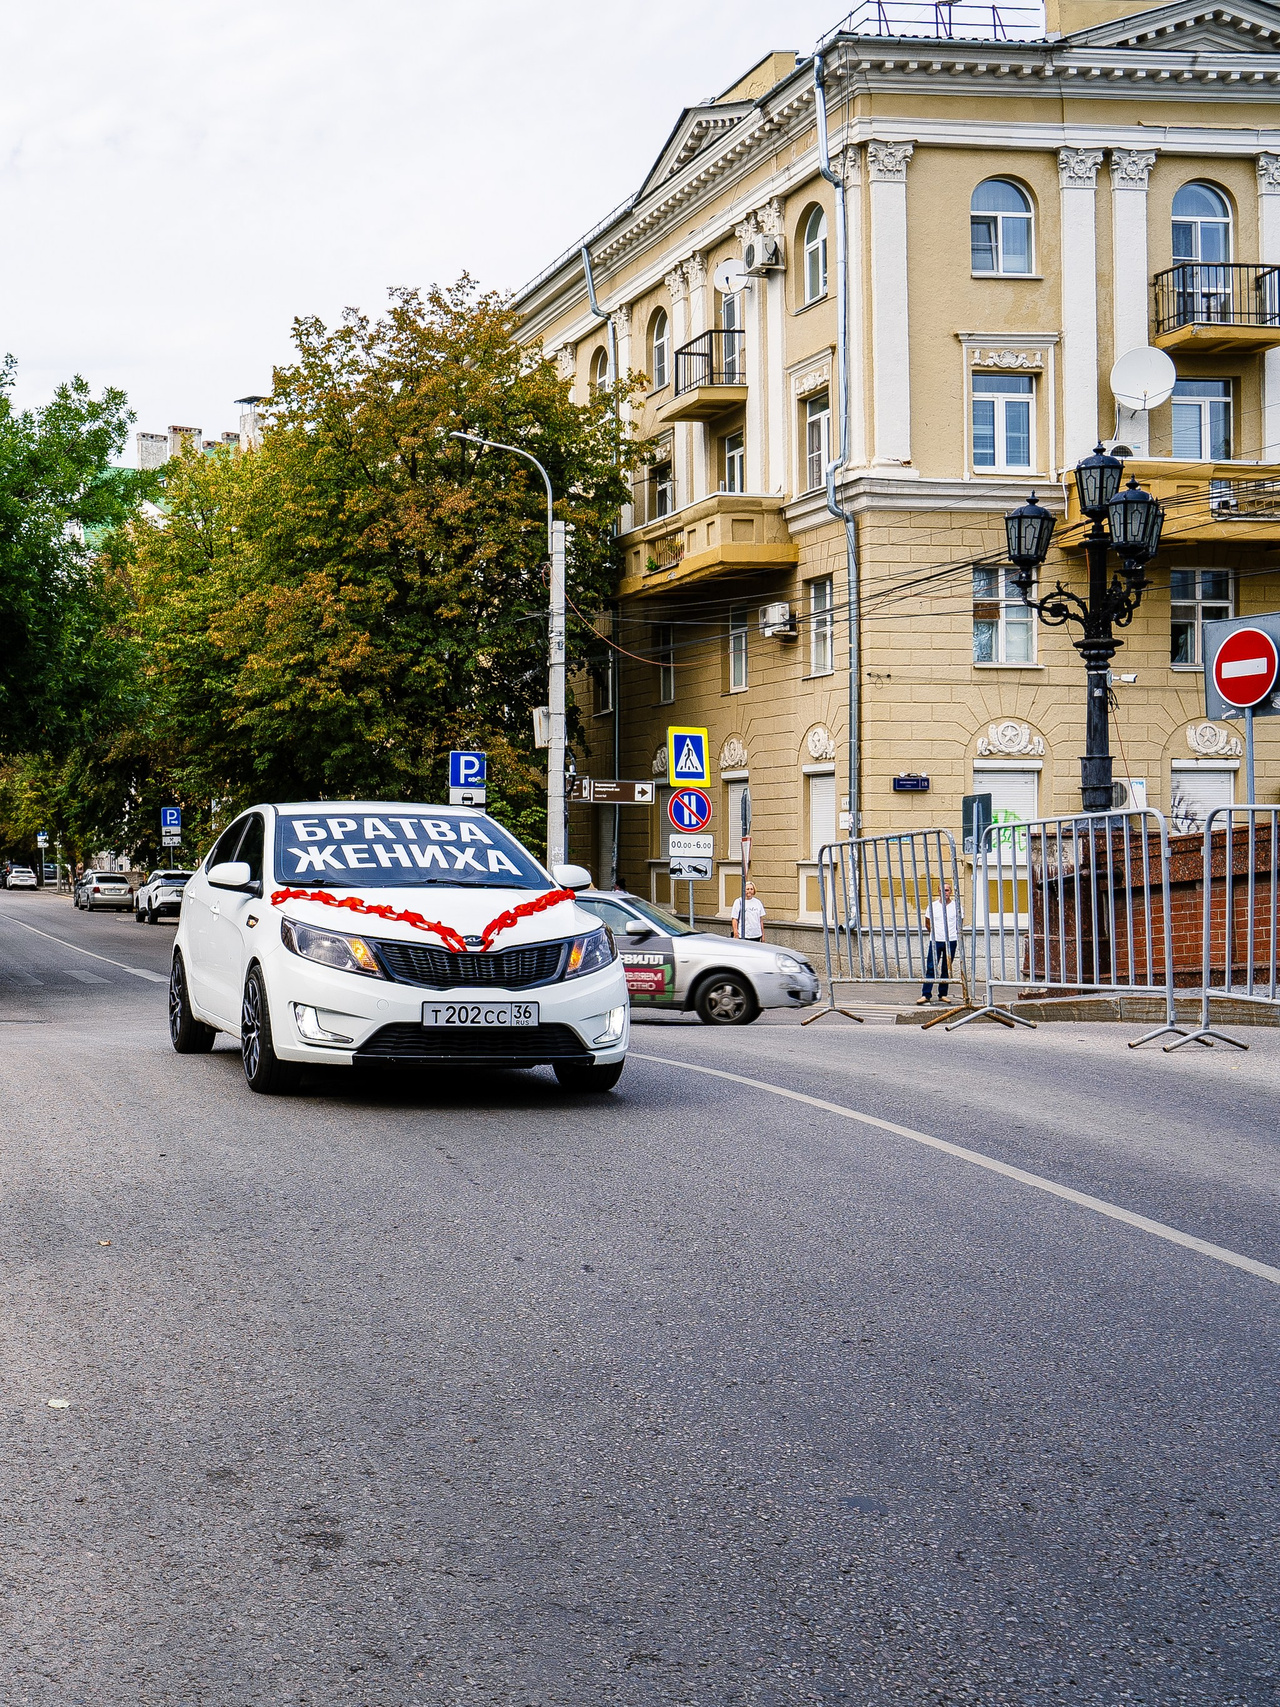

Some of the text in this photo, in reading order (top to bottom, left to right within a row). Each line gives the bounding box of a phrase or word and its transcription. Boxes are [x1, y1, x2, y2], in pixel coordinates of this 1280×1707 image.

[460, 755, 480, 784] P
[166, 809, 177, 825] P
[291, 817, 494, 845] БРАТВА
[286, 844, 523, 876] ЖЕНИХА
[513, 1005, 532, 1019] 36
